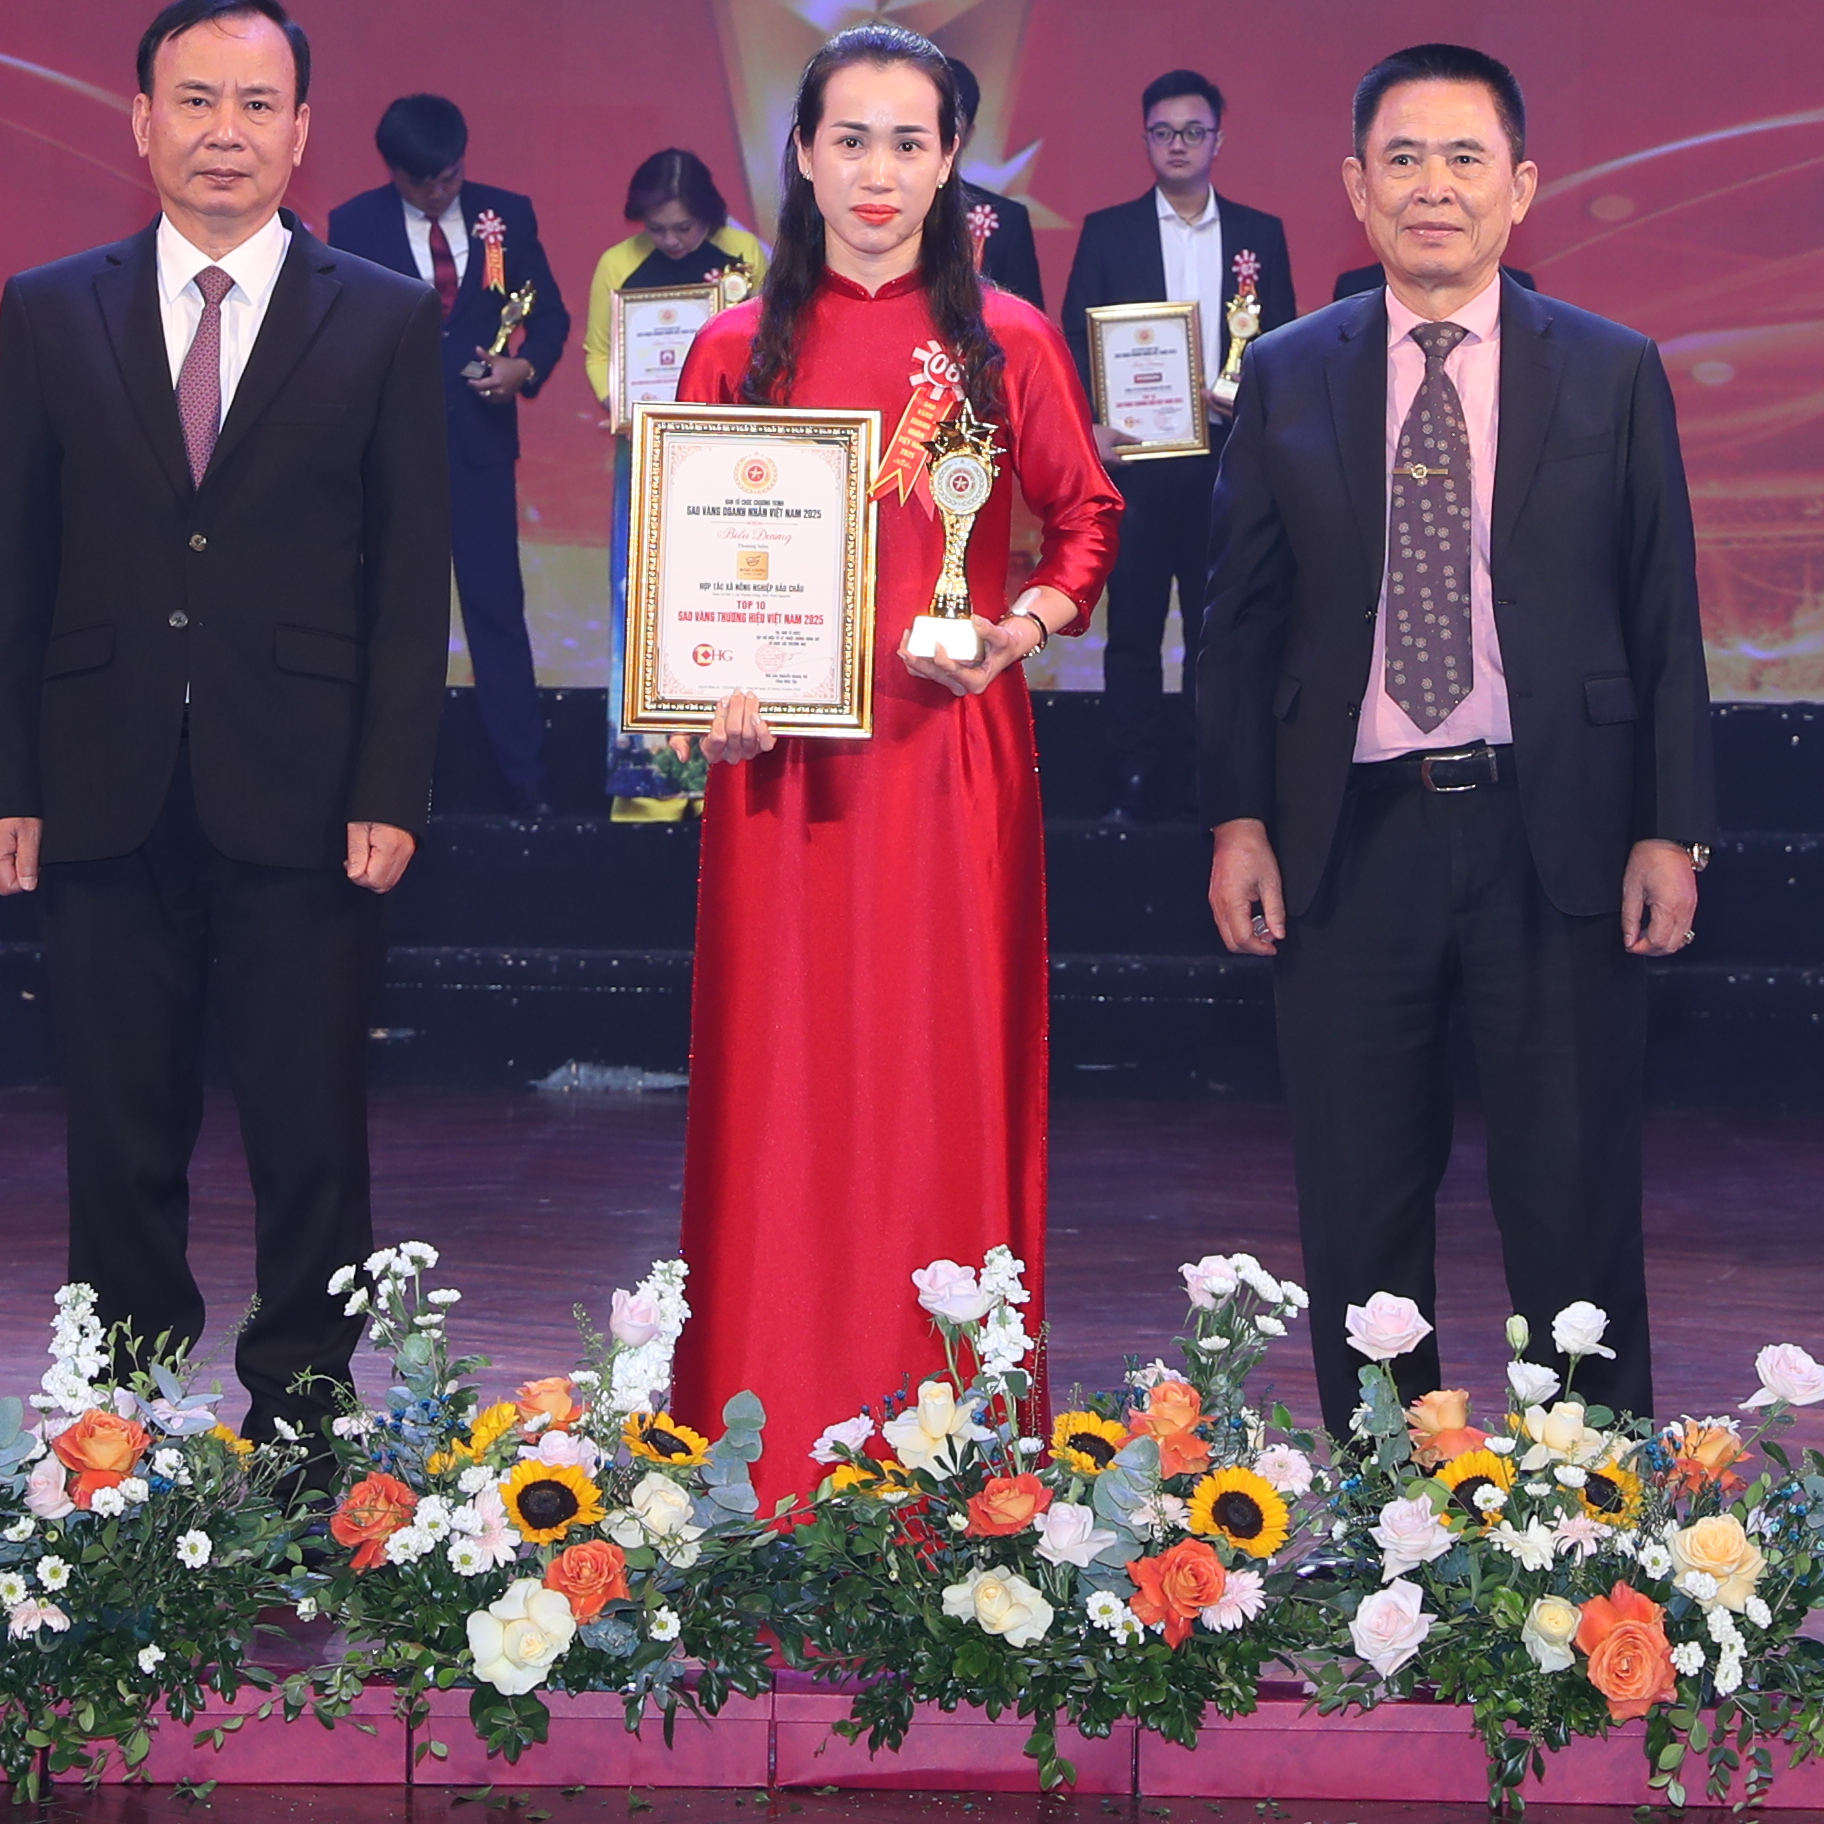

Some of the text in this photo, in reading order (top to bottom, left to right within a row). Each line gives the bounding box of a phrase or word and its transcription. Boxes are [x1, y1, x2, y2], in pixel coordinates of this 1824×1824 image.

[930, 353, 964, 383] 06
[686, 505, 701, 516] SAO
[702, 504, 721, 516] VÀNG
[785, 508, 802, 519] NAM
[803, 508, 822, 519] 2025
[736, 600, 766, 610] TOP 10
[678, 611, 693, 622] SAO
[695, 610, 715, 622] VÀNG
[784, 614, 802, 625] NAM
[804, 614, 824, 625] 2025
